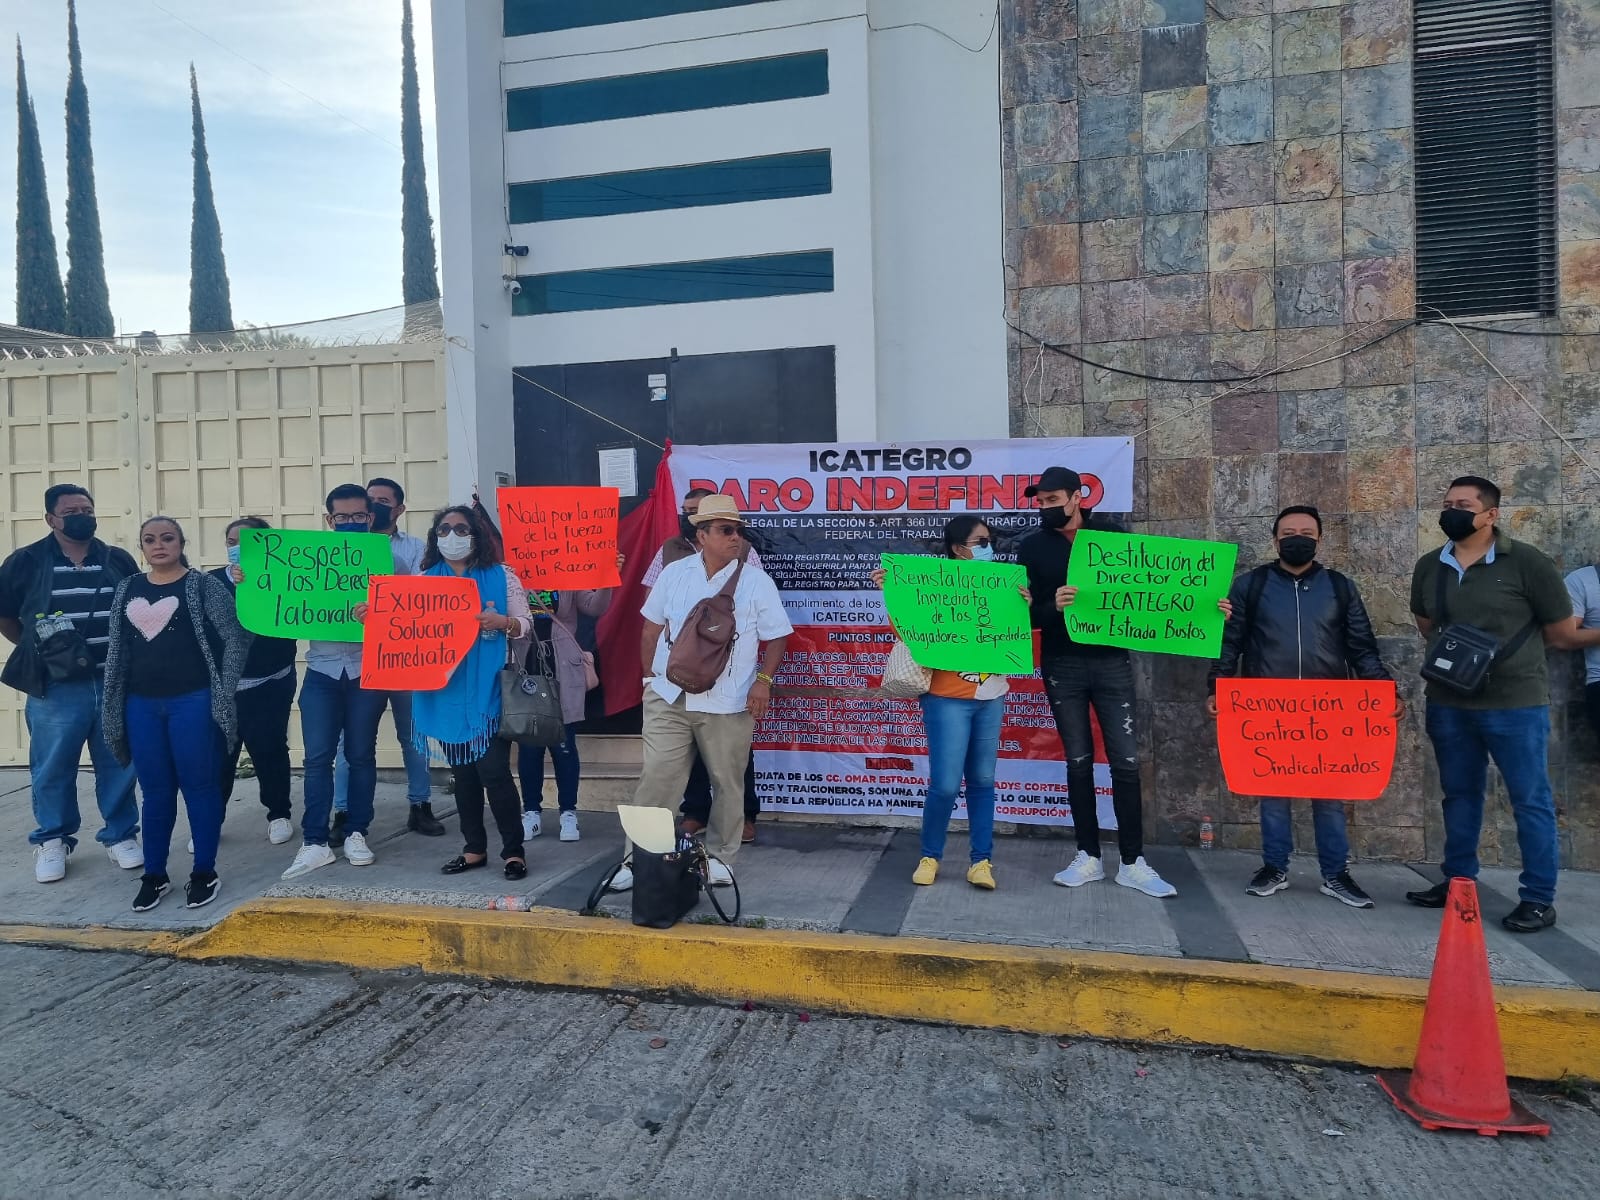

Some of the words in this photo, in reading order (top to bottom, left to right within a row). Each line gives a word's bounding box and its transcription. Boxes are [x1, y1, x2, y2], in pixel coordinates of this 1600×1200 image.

[809, 447, 972, 472] ICATEGRO
[826, 473, 1105, 511] INDEFINIO
[507, 501, 546, 525] Nada
[551, 510, 572, 528] por
[576, 501, 588, 520] la
[782, 518, 798, 528] DE
[800, 518, 814, 527] LA
[817, 516, 866, 528] SECCIÓN
[868, 518, 878, 527] 5.
[906, 518, 925, 527] 366
[982, 516, 1026, 527] RRAFO
[524, 527, 537, 543] de
[544, 526, 557, 541] la
[825, 531, 874, 540] FEDERAL
[877, 530, 898, 539] DEL
[901, 529, 945, 539] TRABAJ
[511, 547, 537, 560] Todo
[541, 548, 560, 562] por
[566, 541, 578, 554] la
[760, 553, 794, 561] TORIDAD
[798, 553, 841, 561] REGISTRAL
[844, 553, 856, 561] NO
[1088, 540, 1191, 571] Destitución
[1196, 552, 1215, 572] del
[520, 568, 532, 579] de
[536, 565, 547, 577] la
[795, 562, 847, 570] REQUERIRLA
[257, 573, 271, 591] a
[287, 571, 314, 592] los
[324, 566, 387, 591] Derech
[775, 570, 822, 579] SIGUIENTES
[824, 571, 831, 579] A
[832, 571, 841, 579] LA
[843, 571, 871, 579] PRESE
[1096, 570, 1171, 585] Director
[1180, 572, 1207, 587] del
[781, 598, 845, 610] umplimiento
[848, 598, 863, 609] de
[865, 599, 881, 609] los
[916, 588, 987, 608] Inmediata
[1096, 591, 1194, 612] ICATEGRO
[812, 612, 875, 622] ICATEGRO
[878, 614, 885, 624] y
[931, 607, 945, 624] de
[951, 604, 972, 623] los
[976, 606, 991, 627] 8
[895, 618, 968, 650] trabajadores
[976, 626, 1031, 648] despedidos
[1069, 614, 1103, 633] Omar
[1109, 614, 1156, 639] Estrada
[1164, 618, 1206, 640] Bustos
[828, 633, 873, 642] PUNTOS
[377, 641, 456, 670] Inmediata
[793, 652, 808, 662] DE
[809, 651, 848, 662] ACOSO
[849, 652, 890, 663] LABORA
[777, 662, 810, 673] ACIÓN
[812, 664, 827, 674] EN
[773, 674, 818, 686] ENTURA
[813, 699, 827, 709] DE
[829, 700, 843, 710] LA
[844, 698, 909, 711] COMPAÑERA
[1230, 690, 1345, 713] Renovación
[1357, 689, 1381, 711] de
[763, 709, 810, 720] ALACIÓN
[813, 711, 827, 721] DE
[829, 711, 843, 721] LA
[819, 723, 833, 733] DE
[834, 723, 878, 734] CUOTAS
[881, 724, 926, 735] SINDICAL
[1241, 716, 1329, 741] Contrato
[1341, 726, 1353, 737] a
[1365, 717, 1391, 737] los
[752, 732, 792, 743] RACIÓN
[794, 734, 847, 745] INMEDIATA
[849, 735, 864, 746] DE
[866, 736, 887, 746] LAS
[889, 737, 928, 747] COMISI
[1253, 746, 1380, 777] Sindicalizados
[754, 771, 785, 780] DIATA
[787, 772, 801, 781] DE
[804, 773, 823, 781] LOS
[844, 775, 876, 783] OMAR
[878, 775, 925, 785] ESTRADA
[777, 784, 784, 792] Y
[787, 784, 866, 796] TRAICIONEROS,
[868, 787, 890, 795] SON
[891, 788, 913, 797] UNA
[994, 781, 1022, 792] ADYS
[776, 797, 789, 805] DE
[792, 797, 805, 805] LA
[808, 796, 865, 807] REPÚBLICA
[868, 798, 883, 807] HA
[886, 799, 924, 809] MANIFE
[1001, 794, 1014, 803] LO
[1018, 795, 1041, 804] QUE
